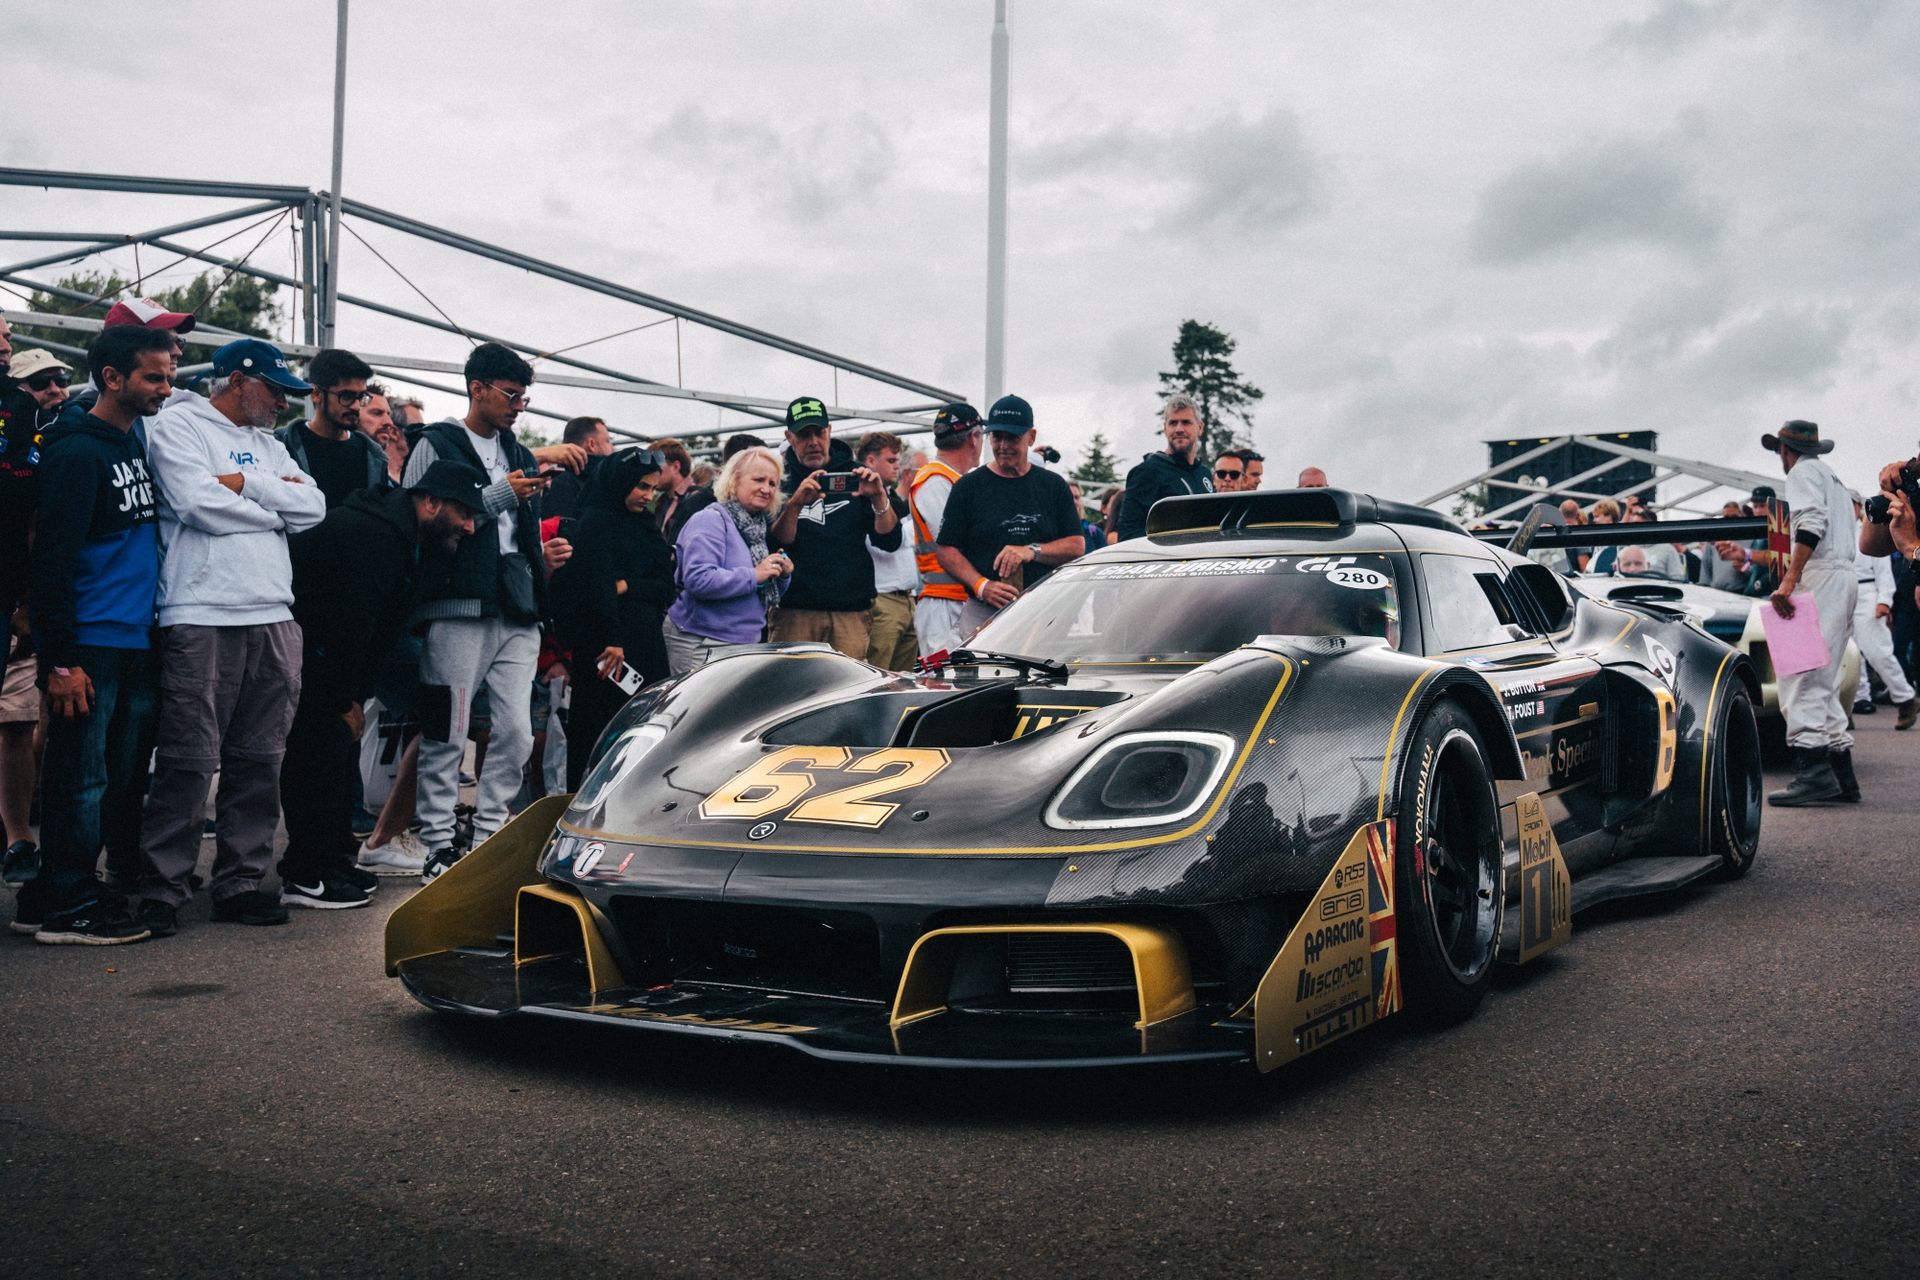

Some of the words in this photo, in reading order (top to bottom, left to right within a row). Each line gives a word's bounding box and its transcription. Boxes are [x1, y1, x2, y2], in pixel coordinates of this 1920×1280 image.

[119, 482, 154, 512] JONE
[1096, 564, 1164, 576] GRAN
[1189, 569, 1265, 577] SIMULATOR
[1337, 572, 1379, 585] 280
[1510, 681, 1537, 696] BUTTON
[1507, 705, 1515, 721] T.
[1514, 701, 1536, 719] FOUST
[698, 745, 952, 829] 62
[1415, 744, 1434, 845] YOKOHAMA
[1522, 830, 1551, 867] Mobil
[1344, 862, 1365, 883] R53
[1323, 893, 1361, 915] aria
[1325, 917, 1364, 949] RACING
[1313, 1000, 1336, 1016] RACING
[1340, 990, 1359, 1005] SEATS
[1293, 994, 1371, 1053] TILLETT
